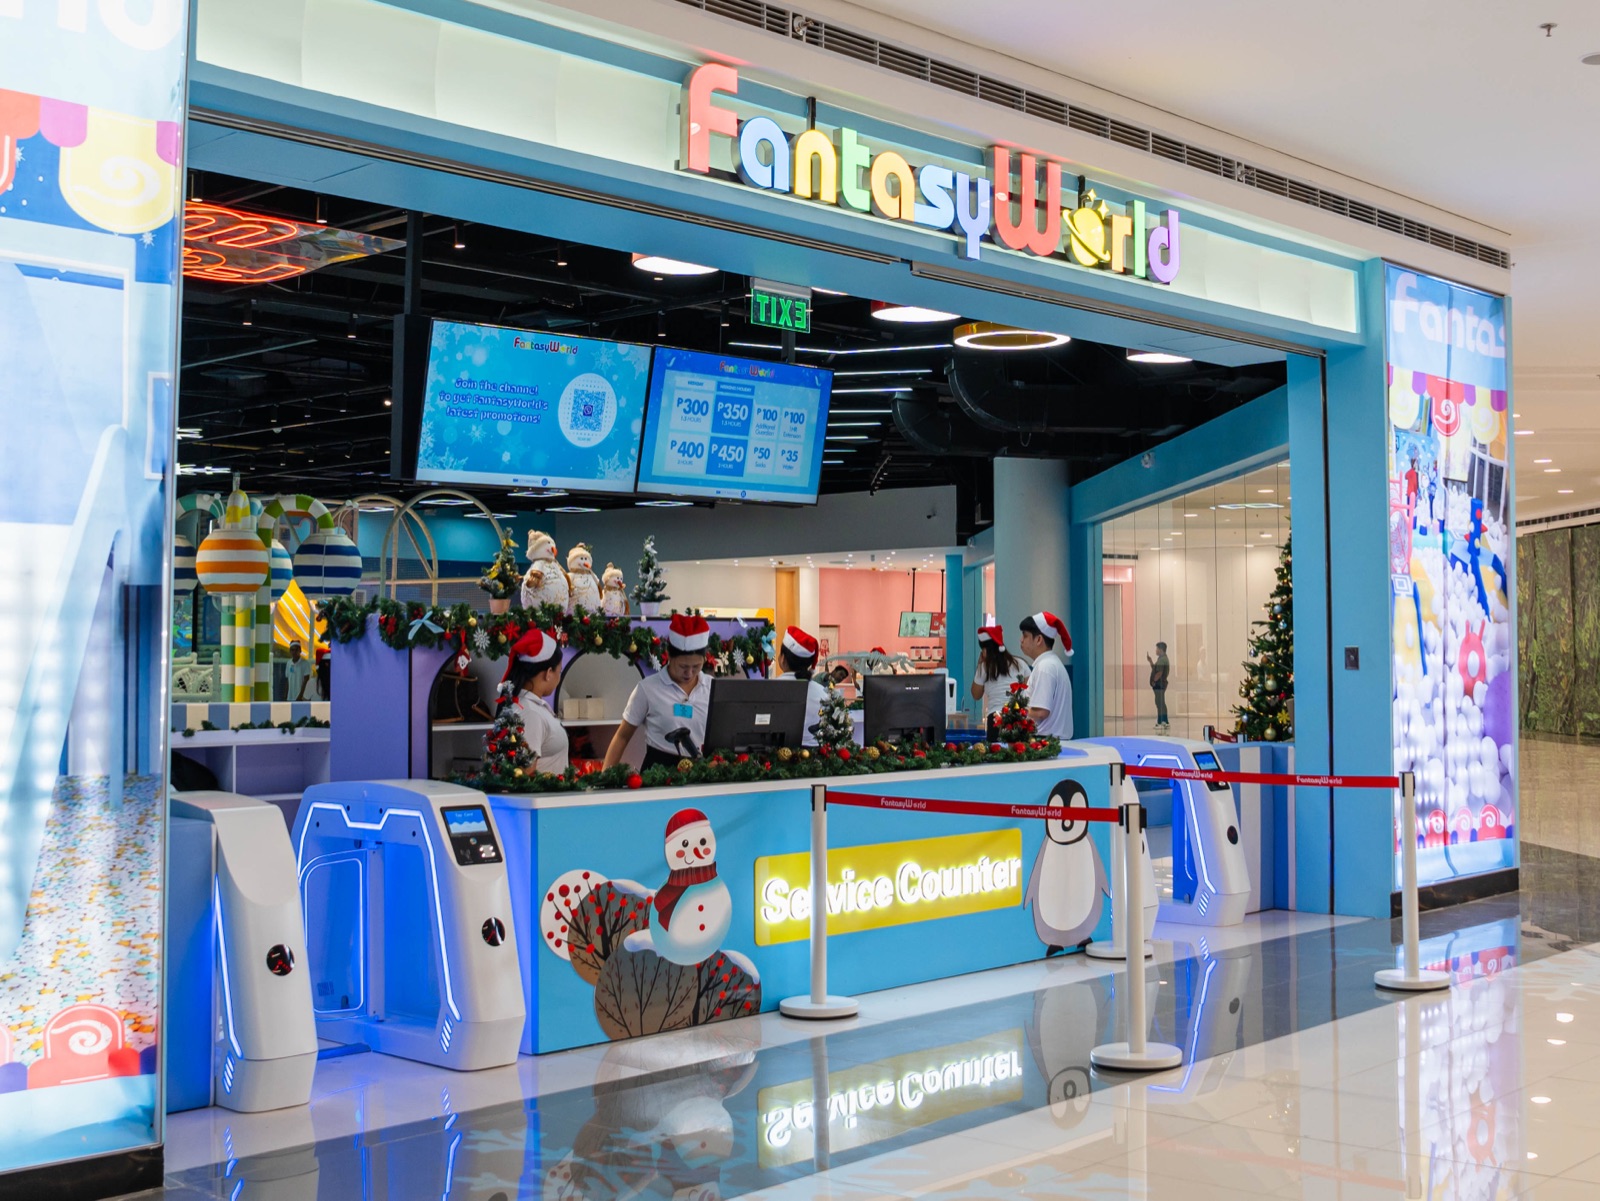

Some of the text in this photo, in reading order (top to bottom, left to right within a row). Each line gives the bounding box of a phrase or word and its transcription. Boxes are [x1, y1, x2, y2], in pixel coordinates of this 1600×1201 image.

[683, 61, 1180, 284] FantasyWorld
[513, 336, 579, 355] FantasyWorld
[455, 378, 539, 396] Join the channel
[439, 390, 451, 401] to
[453, 393, 472, 404] get
[446, 406, 541, 424] latest promotions!
[880, 797, 927, 810] FantasyWorld
[1011, 805, 1062, 818] FantasyWorld
[761, 855, 1022, 924] Sevice Counter
